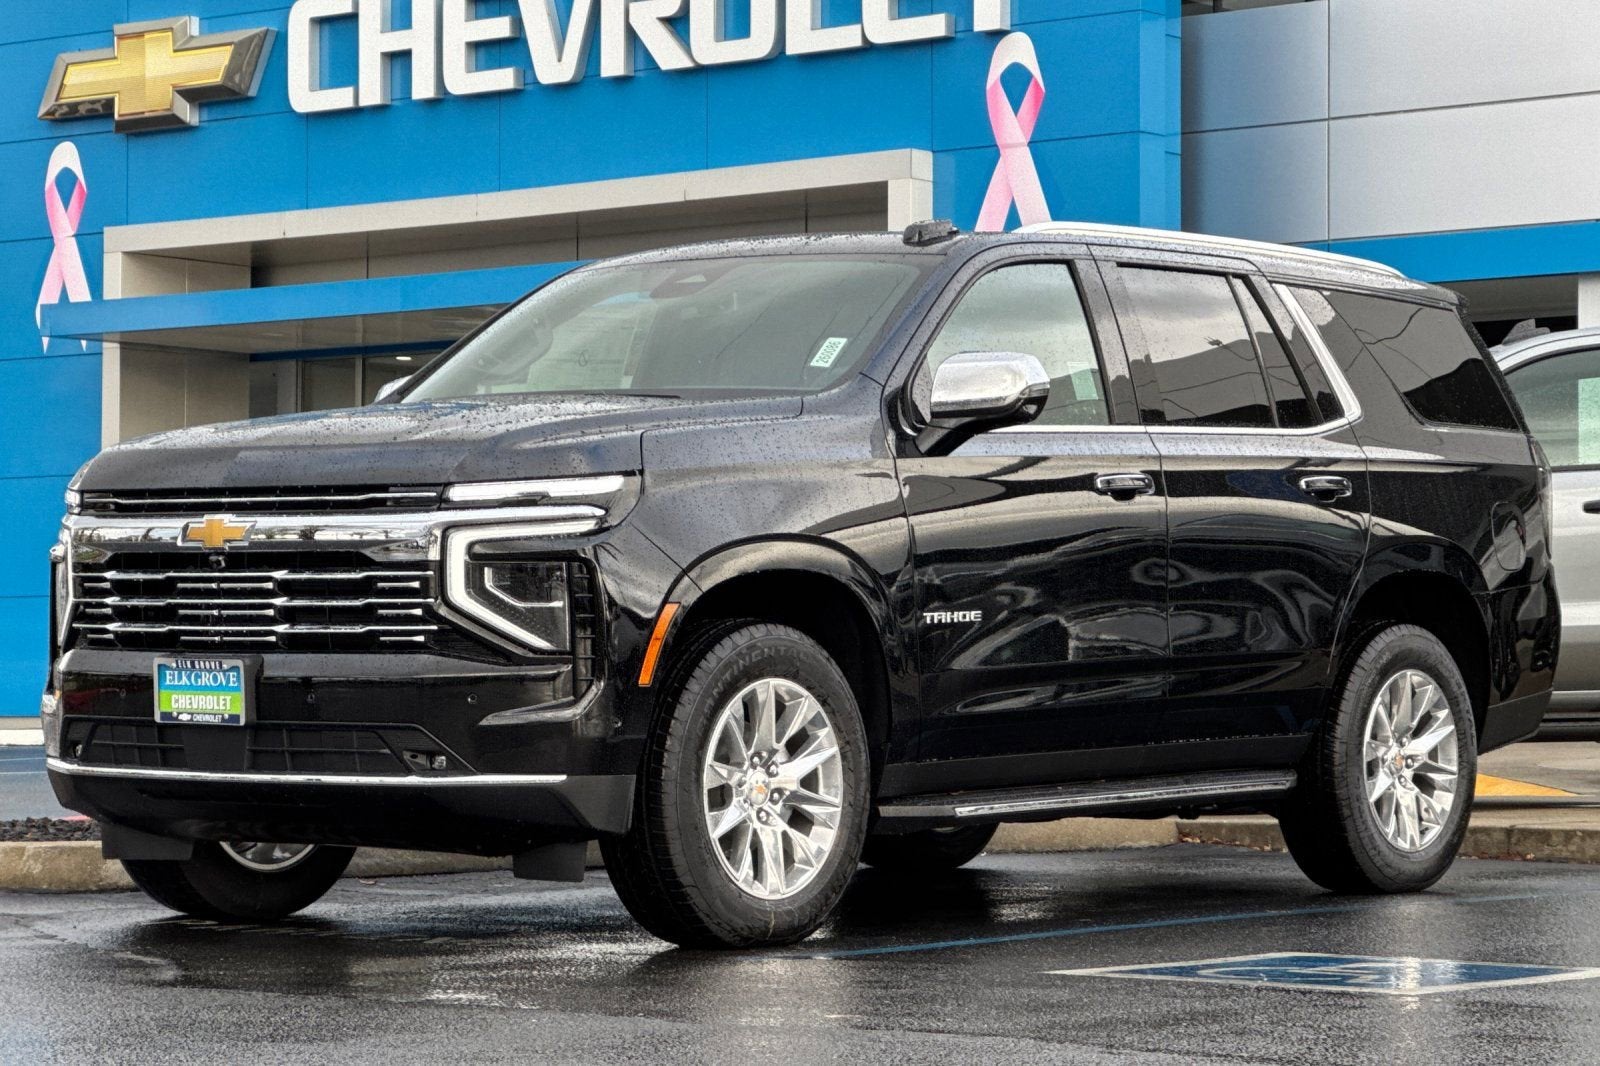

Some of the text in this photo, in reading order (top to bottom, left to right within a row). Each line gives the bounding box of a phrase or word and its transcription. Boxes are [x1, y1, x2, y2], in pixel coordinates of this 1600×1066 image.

[287, 0, 1010, 113] CHEVRO
[923, 610, 982, 624] TAHOE
[171, 694, 231, 710] CHEVROLET
[192, 713, 222, 722] CHEVROLET
